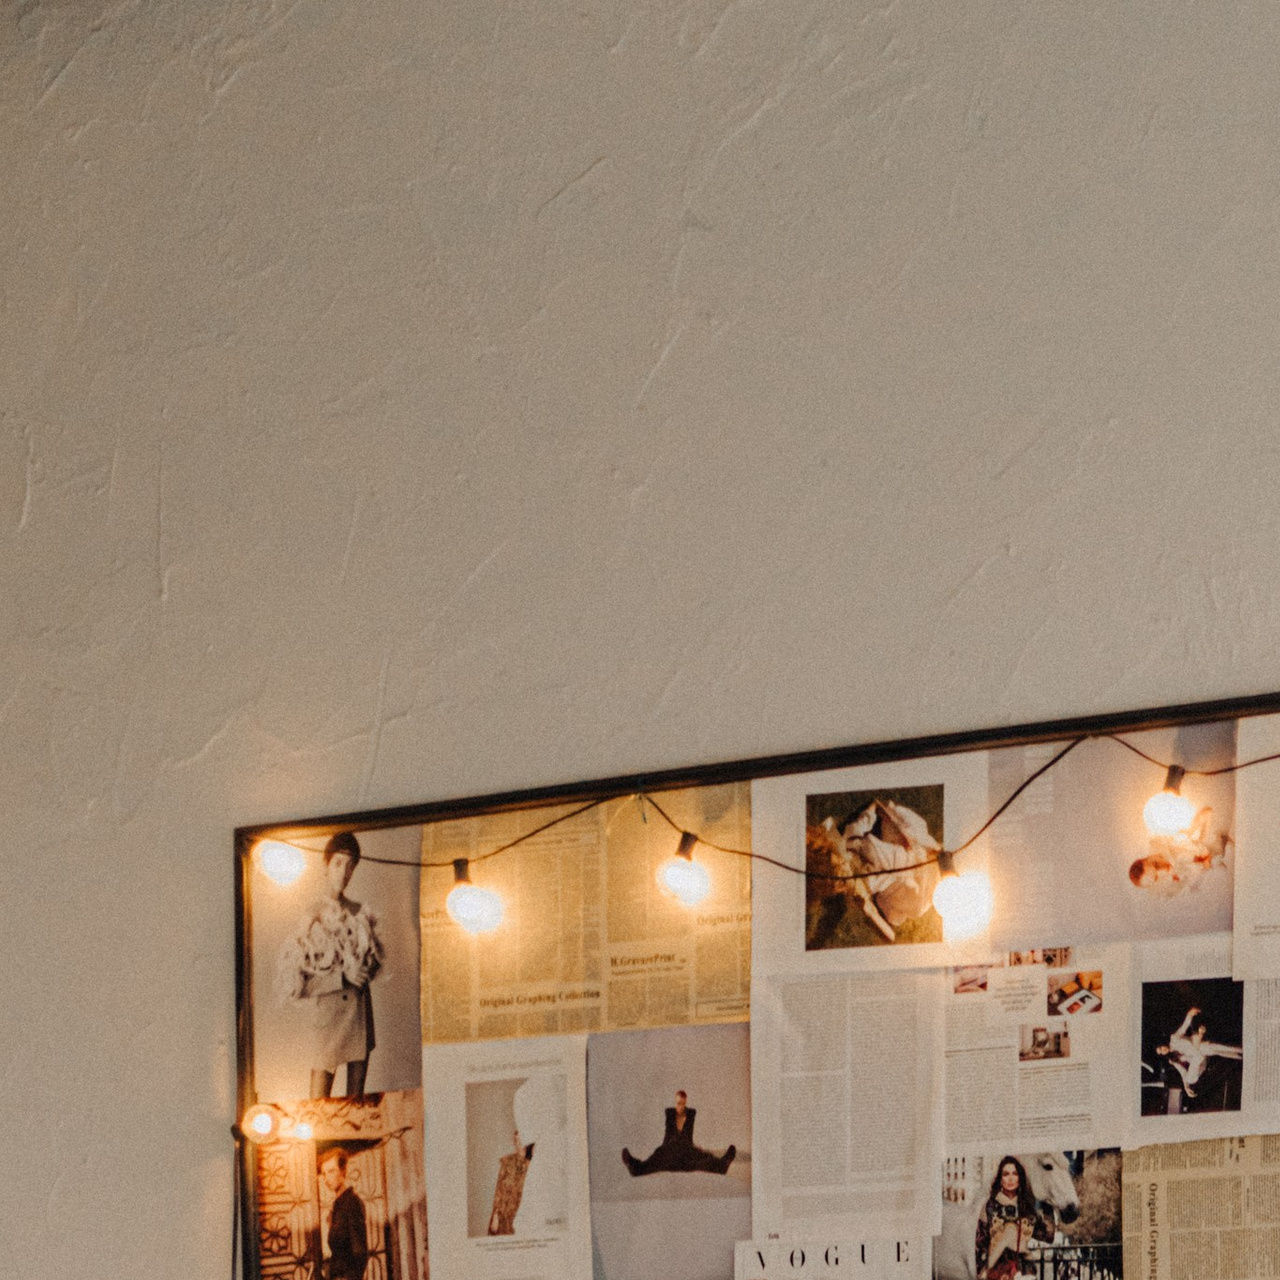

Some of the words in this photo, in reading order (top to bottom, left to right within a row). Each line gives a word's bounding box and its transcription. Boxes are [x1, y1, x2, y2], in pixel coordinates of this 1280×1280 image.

[1148, 1182, 1159, 1227] Original
[756, 1240, 910, 1271] VOGUE
[1148, 1229, 1159, 1280] Graphing
